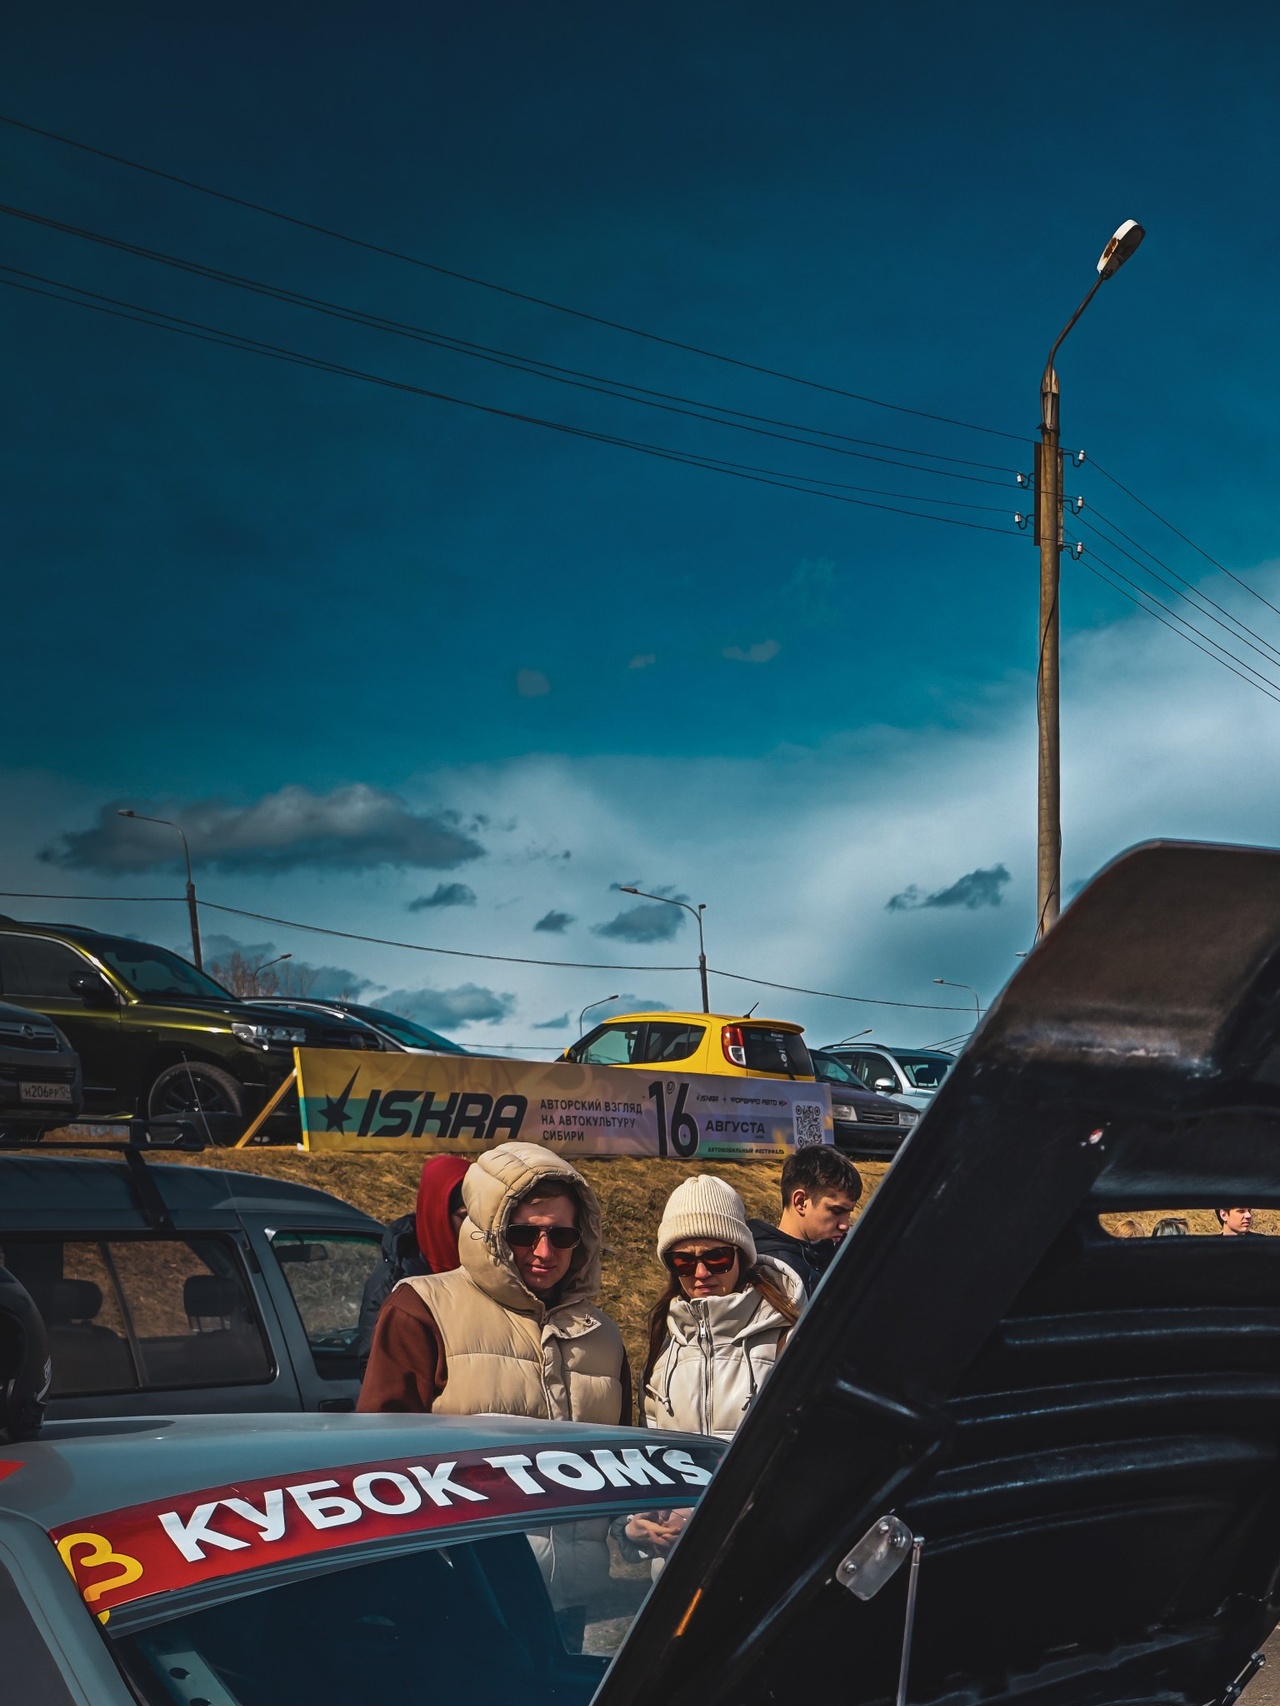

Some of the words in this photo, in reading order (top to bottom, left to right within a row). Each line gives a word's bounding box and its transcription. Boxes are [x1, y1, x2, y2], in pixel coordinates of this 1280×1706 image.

[356, 1088, 529, 1140] ISKRA
[540, 1098, 602, 1112] АВТОРСКИЙ
[604, 1101, 643, 1116] ВЗГЛЯД
[541, 1114, 556, 1126] НА
[558, 1114, 636, 1128] АВТОКУЛЬТУРУ
[648, 1080, 700, 1158] 16
[705, 1120, 766, 1134] АВГУСТА
[542, 1129, 585, 1141] СИБИРИ
[157, 1461, 489, 1562] КУБОК
[482, 1445, 714, 1495] TOM'S
